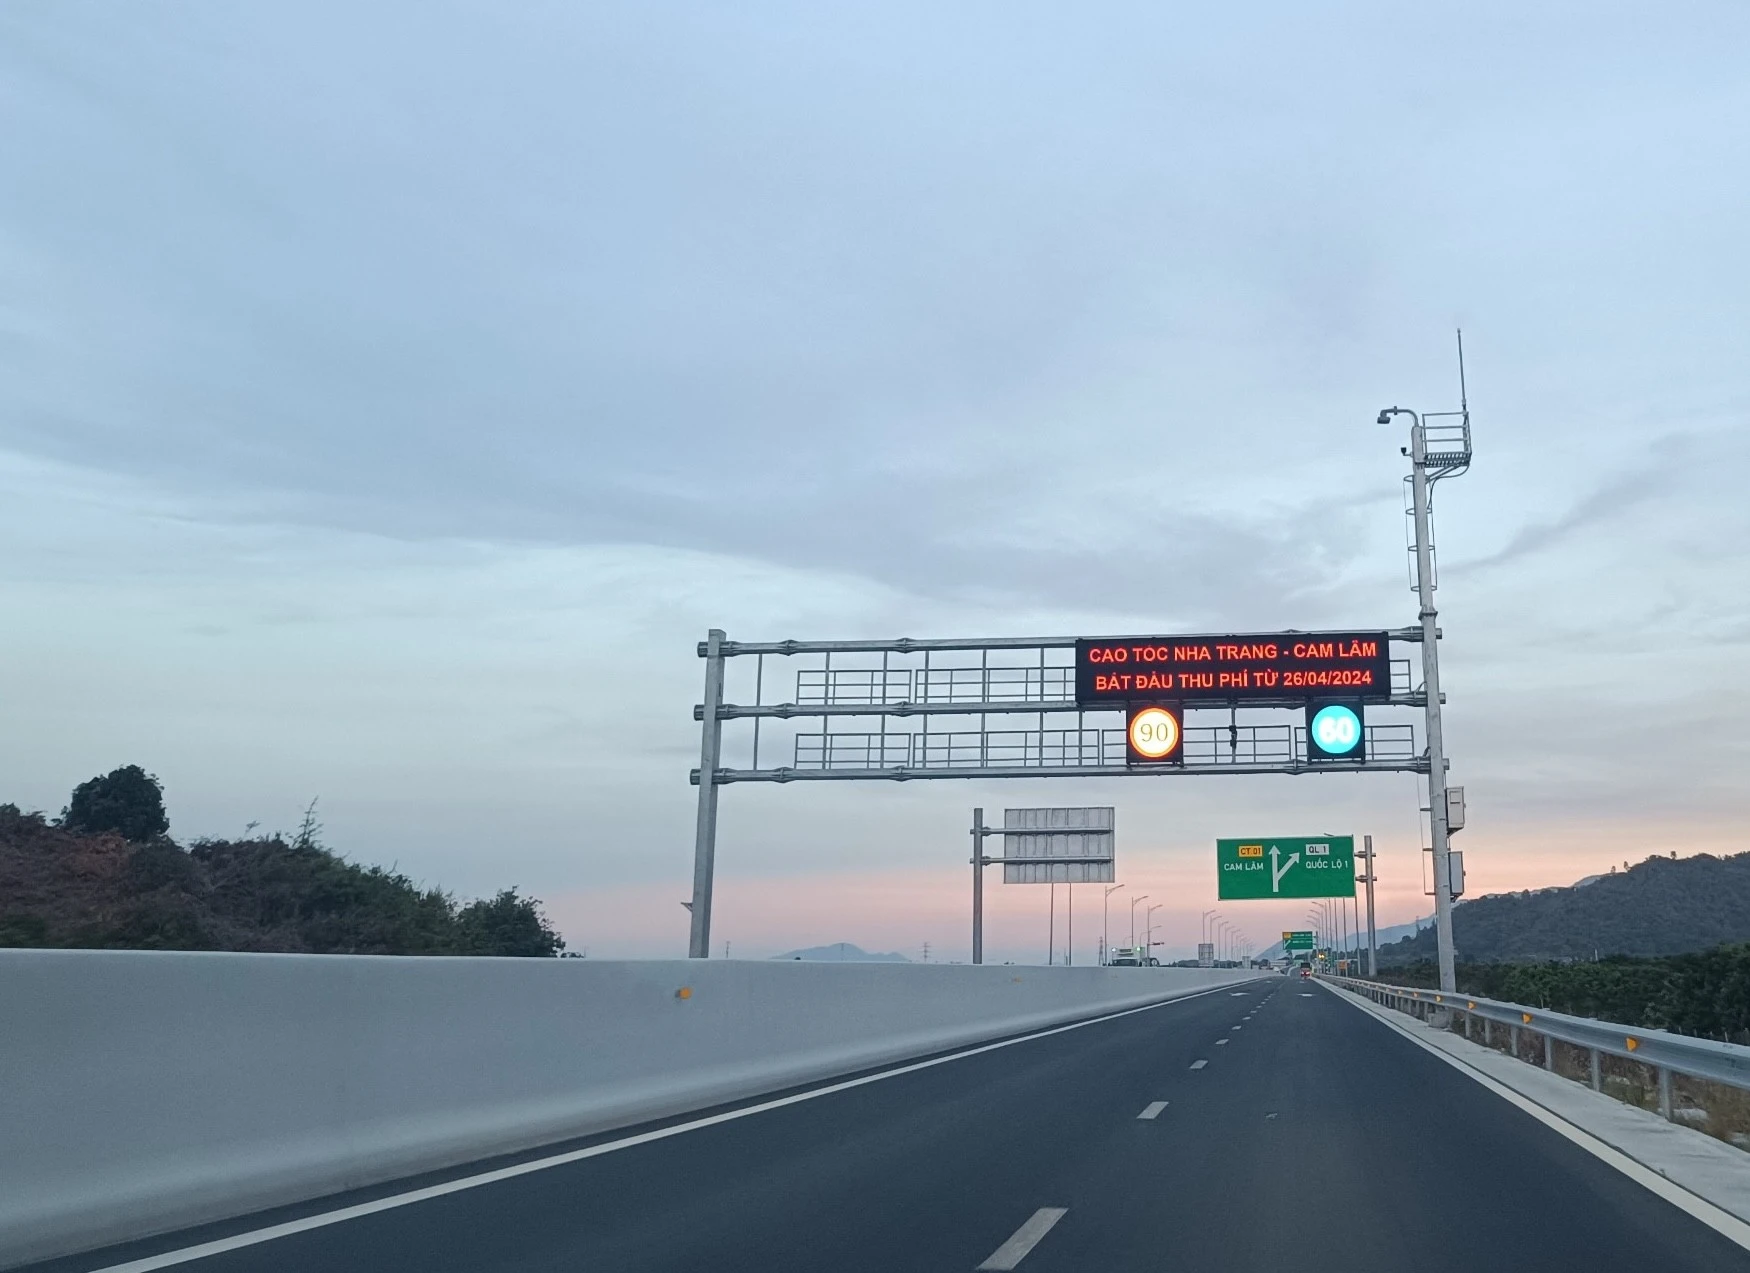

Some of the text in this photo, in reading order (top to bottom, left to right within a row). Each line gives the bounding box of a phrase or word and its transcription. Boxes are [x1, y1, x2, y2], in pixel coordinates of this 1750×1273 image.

[1089, 647, 1128, 663] CAO
[1174, 646, 1212, 661] NHA
[1216, 644, 1278, 661] TRANG
[1293, 643, 1334, 658] CAM
[1178, 673, 1213, 688] THU
[1219, 667, 1248, 687] PHÍ
[1253, 667, 1279, 687] TỪ
[1283, 669, 1373, 686] 26/04/2024
[1140, 722, 1168, 743] 90
[1319, 716, 1354, 744] 60
[1308, 845, 1319, 854] QL
[1223, 862, 1243, 871] CAM
